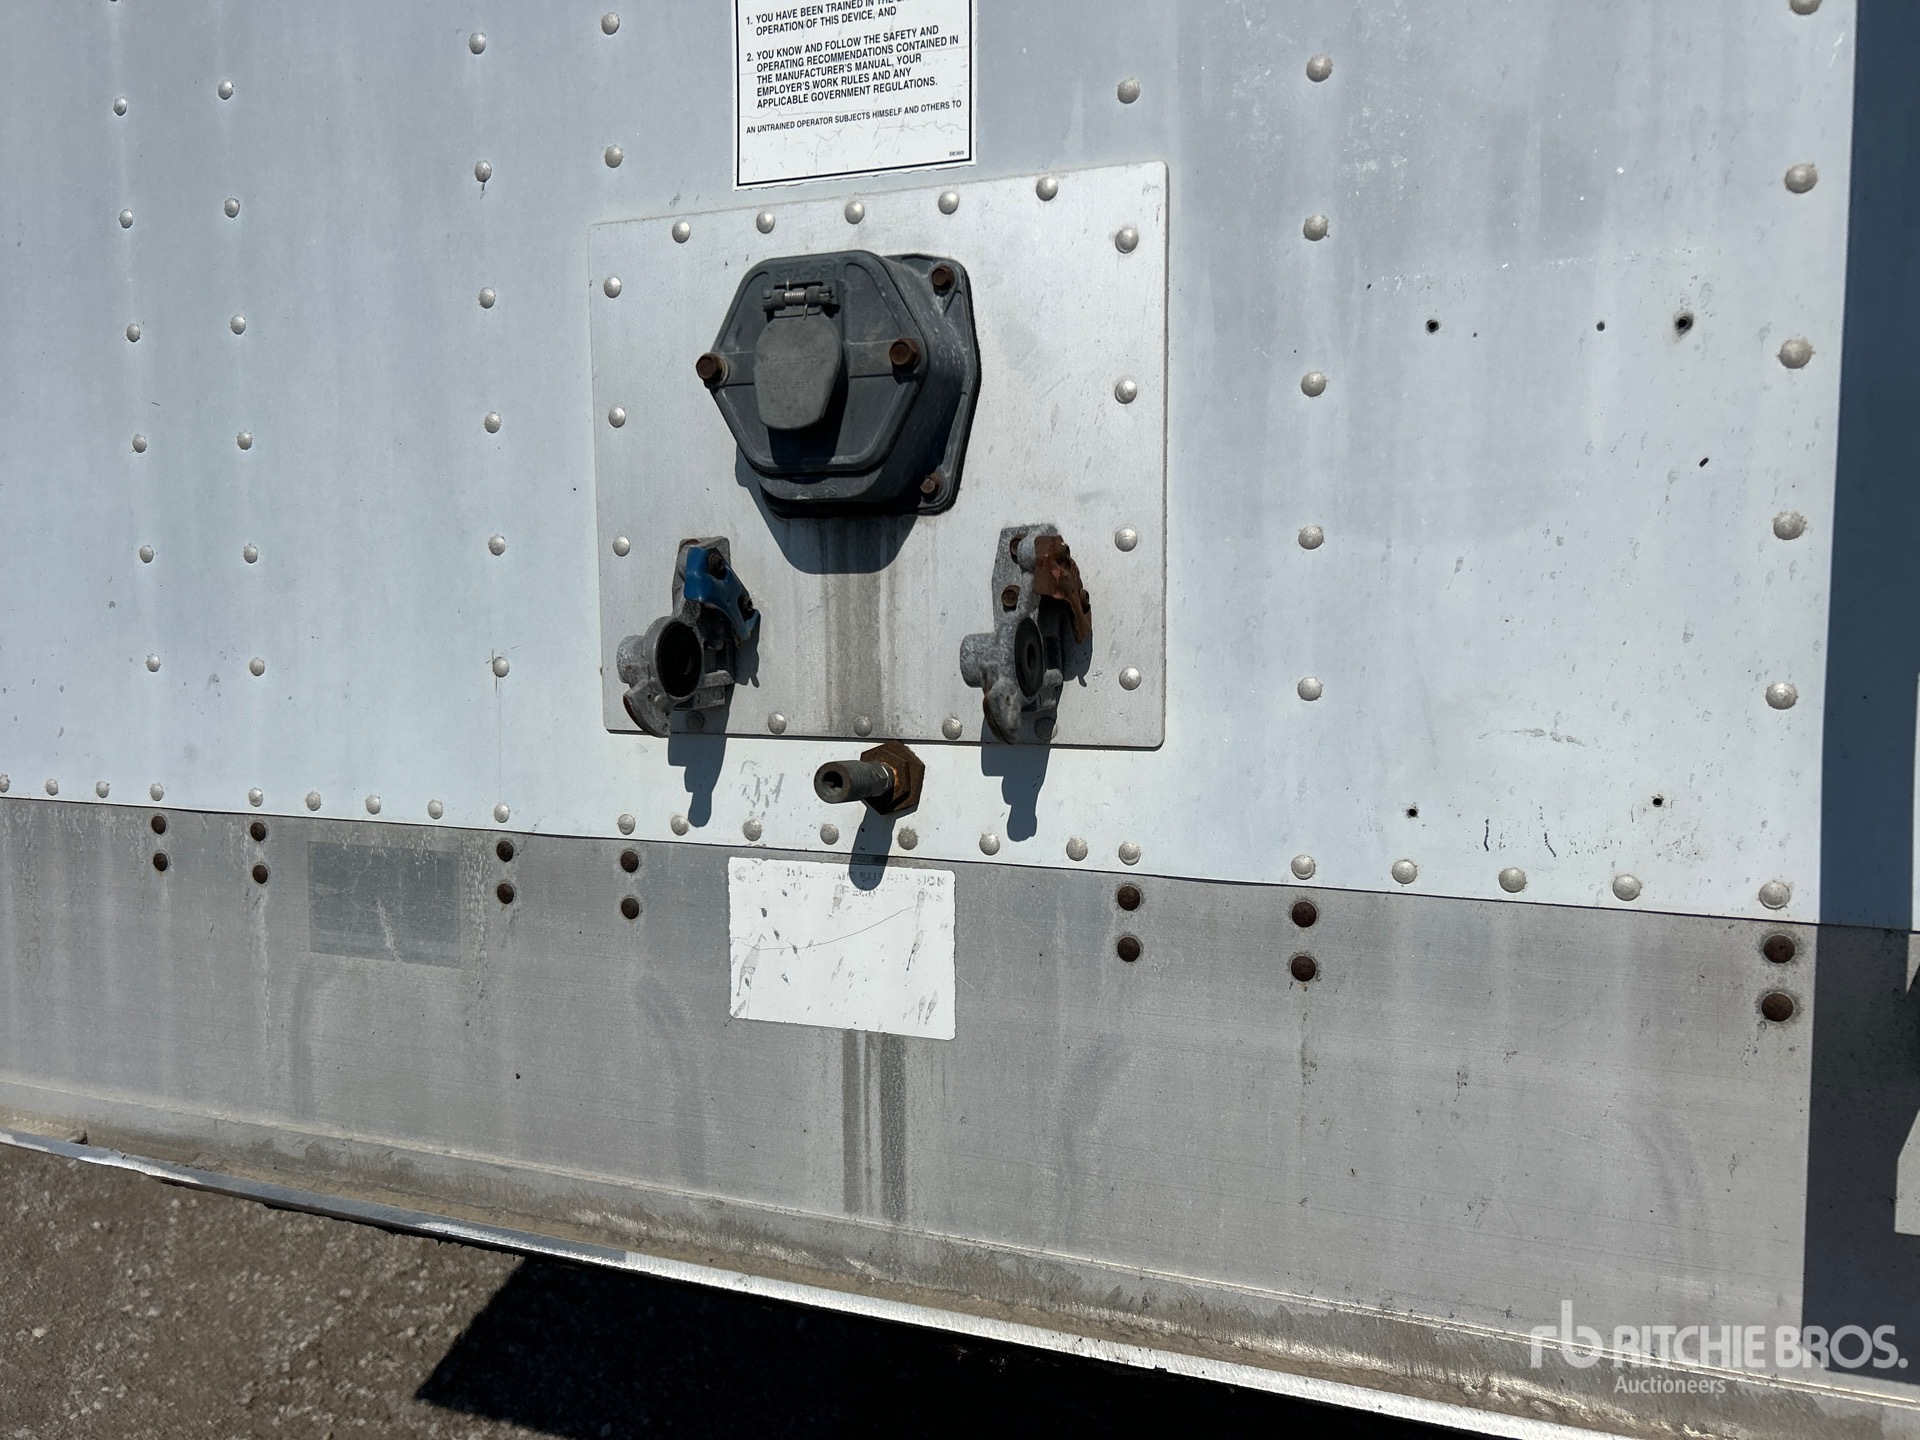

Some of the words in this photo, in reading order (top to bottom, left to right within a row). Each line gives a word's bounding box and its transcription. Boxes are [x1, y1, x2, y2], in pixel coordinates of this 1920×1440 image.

[746, 16, 753, 25] 1.
[756, 13, 773, 24] YOU
[776, 9, 798, 21] HAVE
[800, 5, 823, 17] BEEN
[826, 0, 863, 13] TRAINED
[756, 20, 804, 36] OPERATION
[806, 18, 817, 29] OF
[820, 14, 839, 26] THIS
[841, 9, 876, 23] DEVICE,
[878, 6, 897, 17] AND
[746, 53, 753, 62] 2.
[756, 49, 774, 60] YOU
[776, 45, 803, 58] KNOW
[805, 42, 823, 53] AND
[825, 36, 861, 51] FOLLOW
[864, 33, 881, 45] THE
[883, 28, 917, 42] SAFETY
[920, 25, 939, 36] AND
[756, 57, 804, 73] OPERATING
[806, 44, 894, 66] RECOMMENDATIONS
[896, 36, 947, 52] CONTAINED
[949, 35, 959, 45] IN
[757, 74, 773, 85] THE
[775, 63, 853, 82] MANUFACTURER'S
[855, 57, 894, 71] MANUAL,
[897, 53, 922, 65] YOUR
[757, 81, 810, 97] EMPLOYER'S
[812, 77, 839, 90] WORK
[841, 73, 870, 85] RULES
[872, 70, 891, 81] AND
[893, 67, 912, 78] ANY
[757, 94, 808, 109] APPLICABLE
[811, 85, 871, 102] GOVERNMENT
[873, 76, 938, 94] REGULATIONS.
[746, 126, 756, 134] AN
[757, 120, 795, 133] UNTRAINED
[796, 116, 833, 128] OPERATOR
[834, 111, 871, 124] SUBJECTS
[872, 107, 902, 119] HIMSELF
[904, 105, 919, 114] AND
[920, 101, 950, 112] OTHERS
[952, 99, 962, 108] TO
